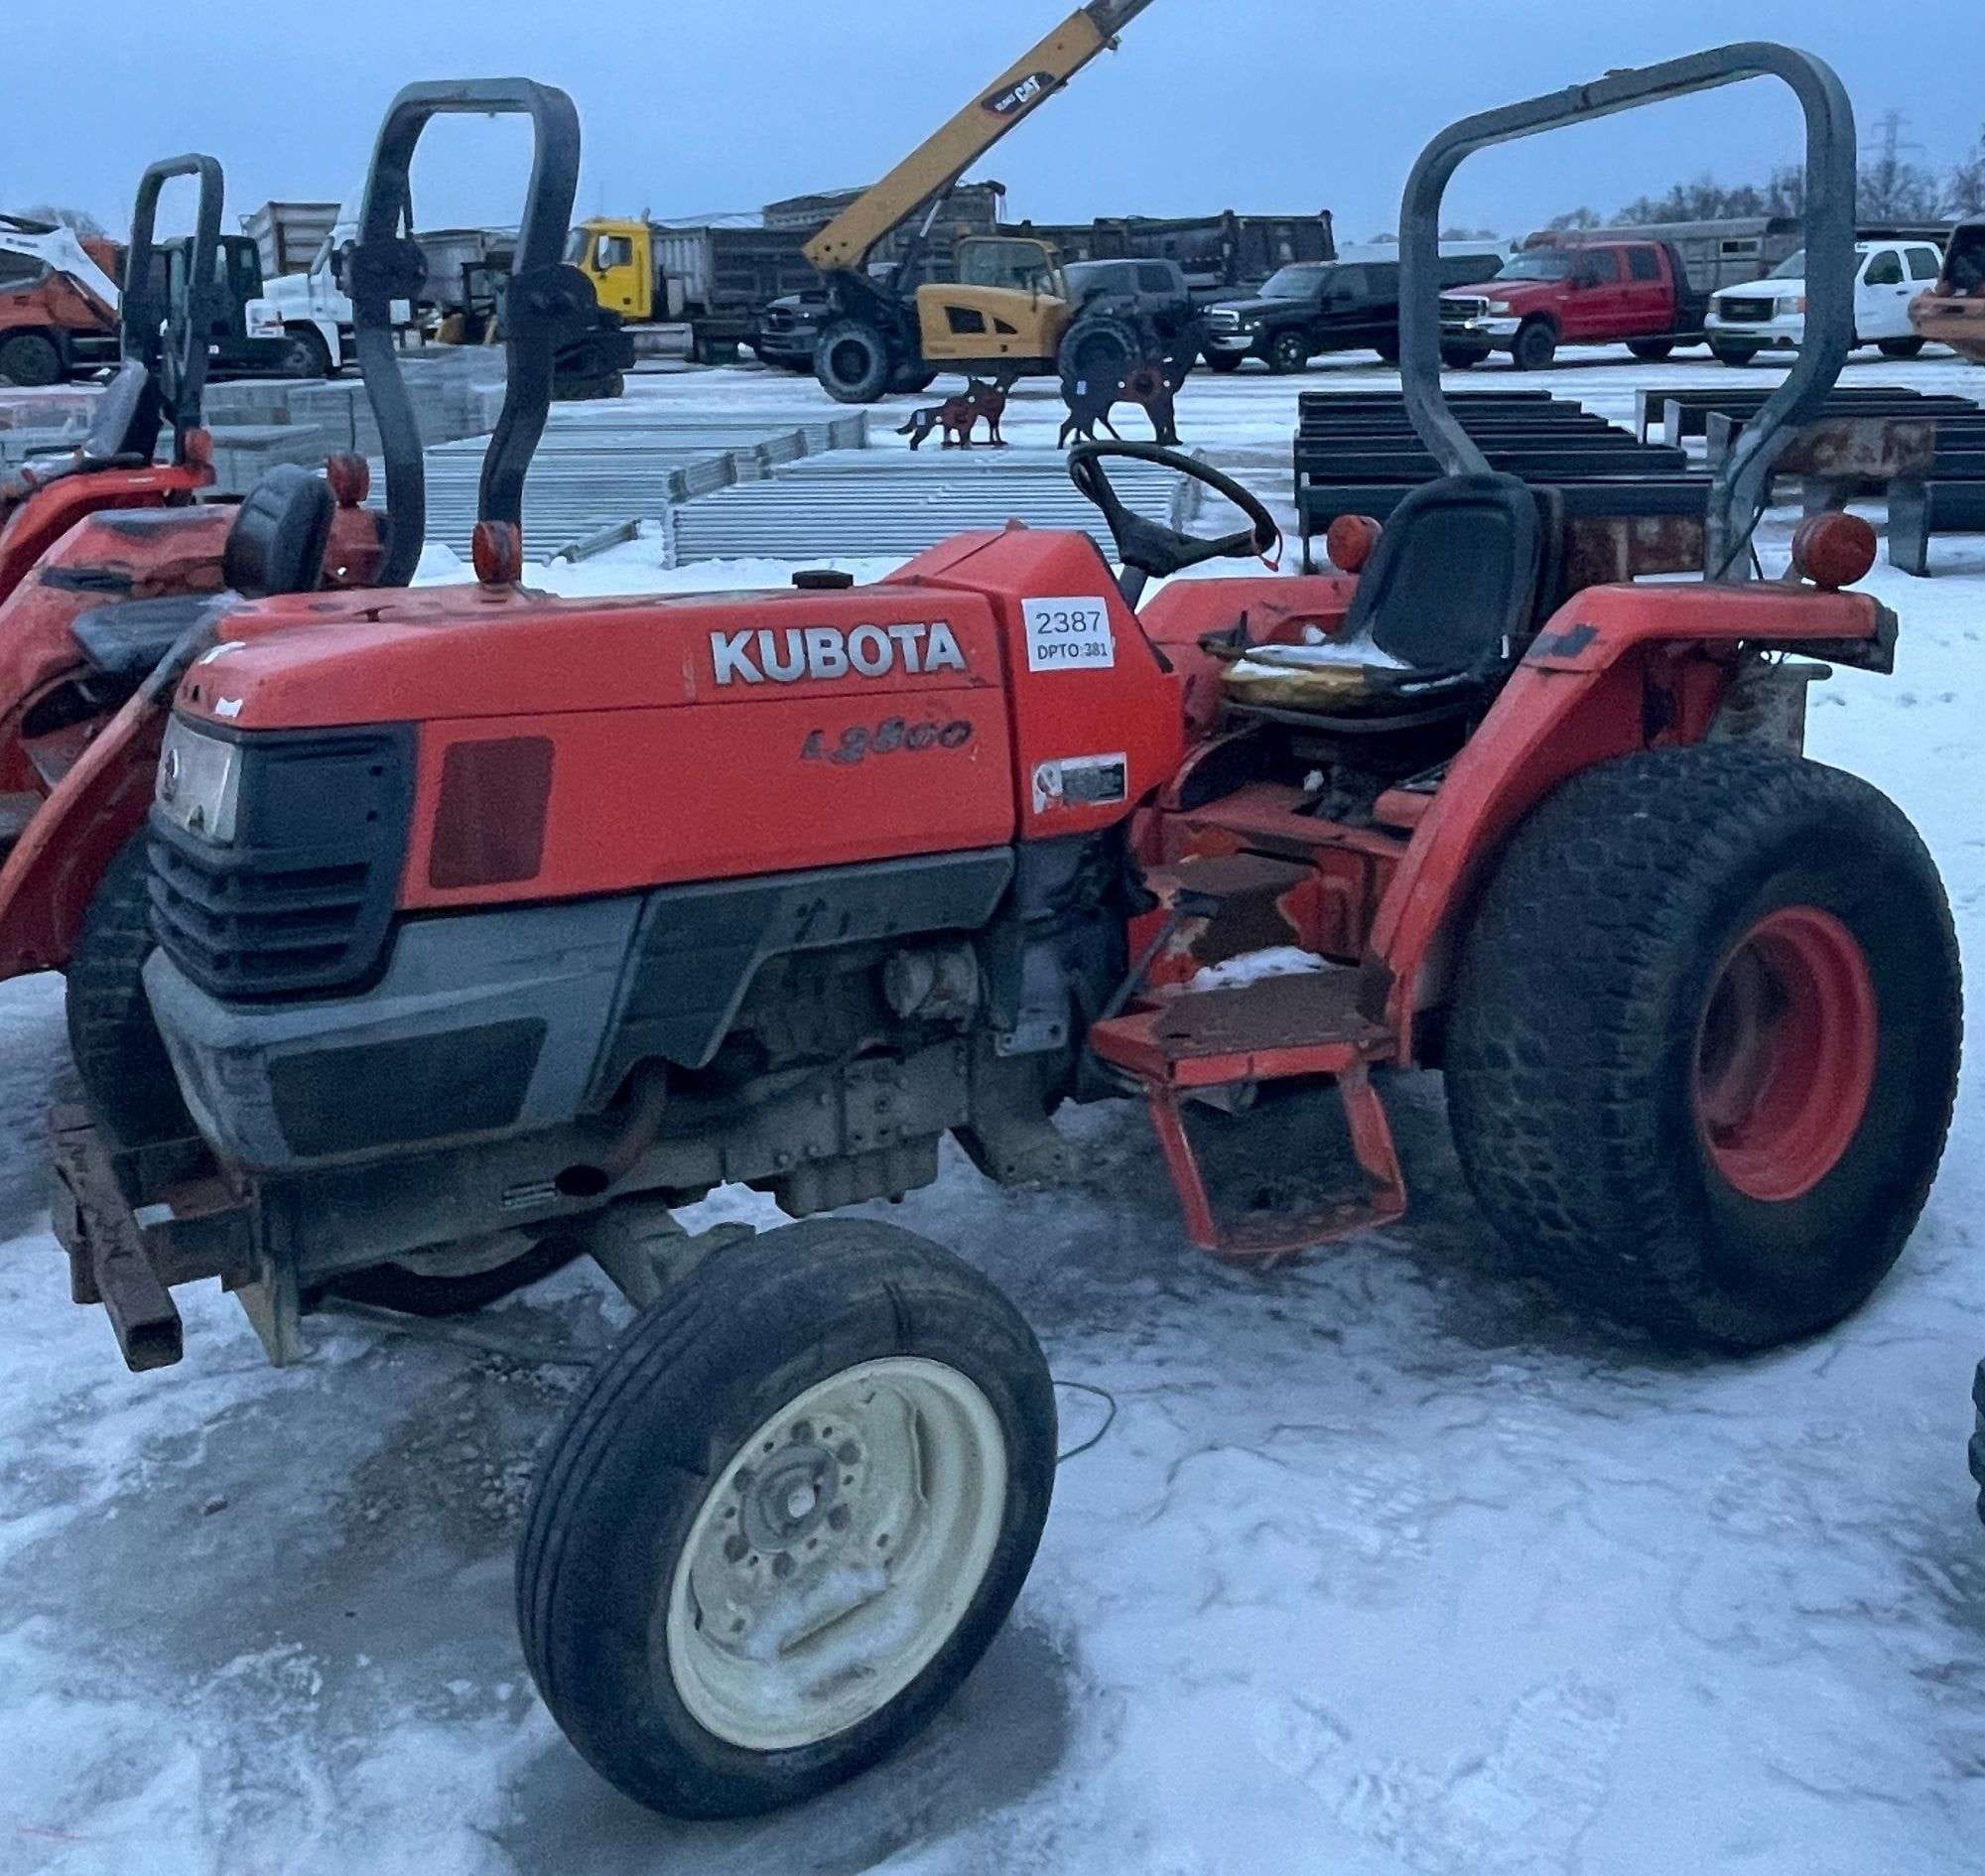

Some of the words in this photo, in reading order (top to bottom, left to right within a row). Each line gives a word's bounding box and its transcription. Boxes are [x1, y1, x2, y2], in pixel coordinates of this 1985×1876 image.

[1014, 74, 1041, 102] CAT
[1035, 610, 1101, 634] 2387
[711, 620, 966, 686] KUBOTA
